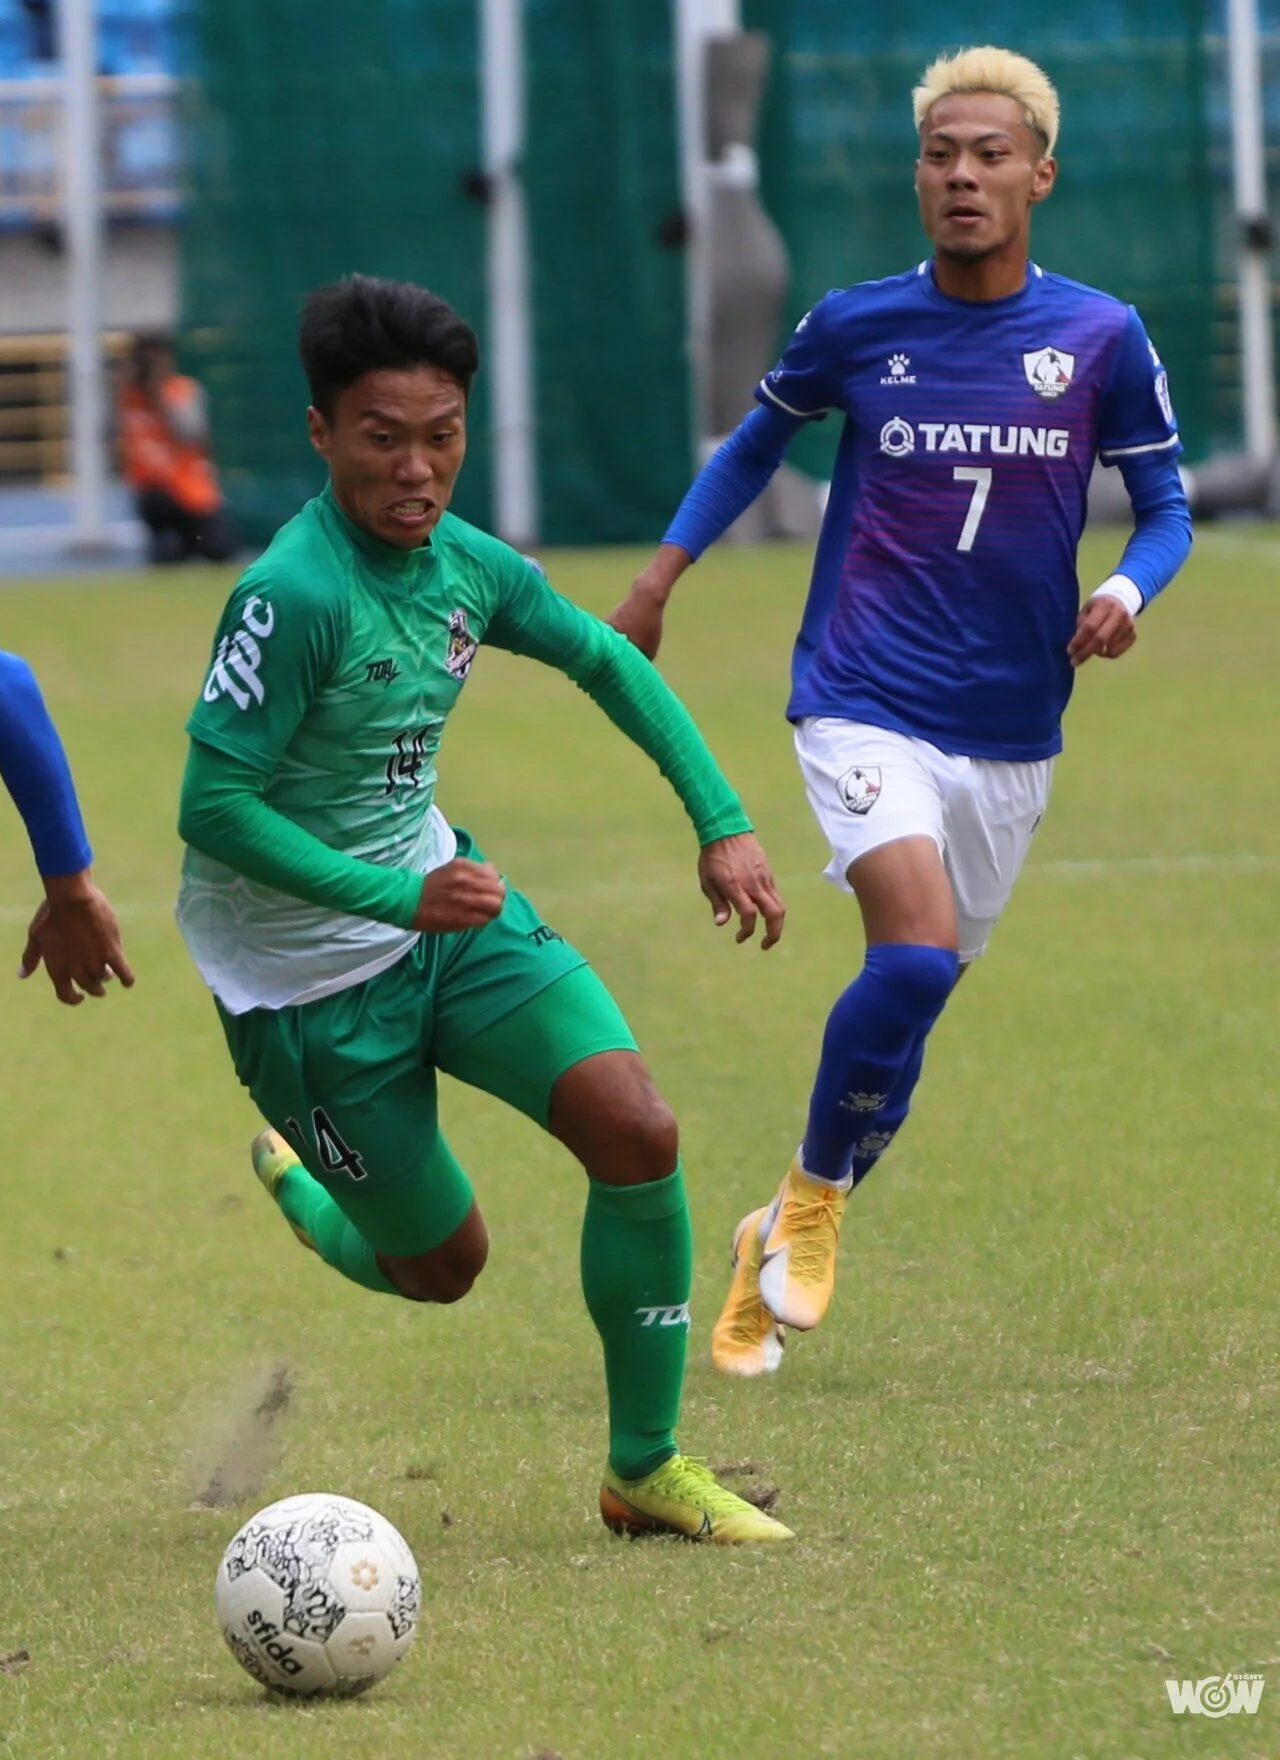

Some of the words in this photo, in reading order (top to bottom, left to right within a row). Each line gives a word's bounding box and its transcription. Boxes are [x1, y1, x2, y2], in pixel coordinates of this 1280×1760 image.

[880, 375, 917, 385] KELME
[918, 422, 1069, 457] TATUNG
[953, 466, 993, 552] 7
[246, 1608, 304, 1676] sfida
